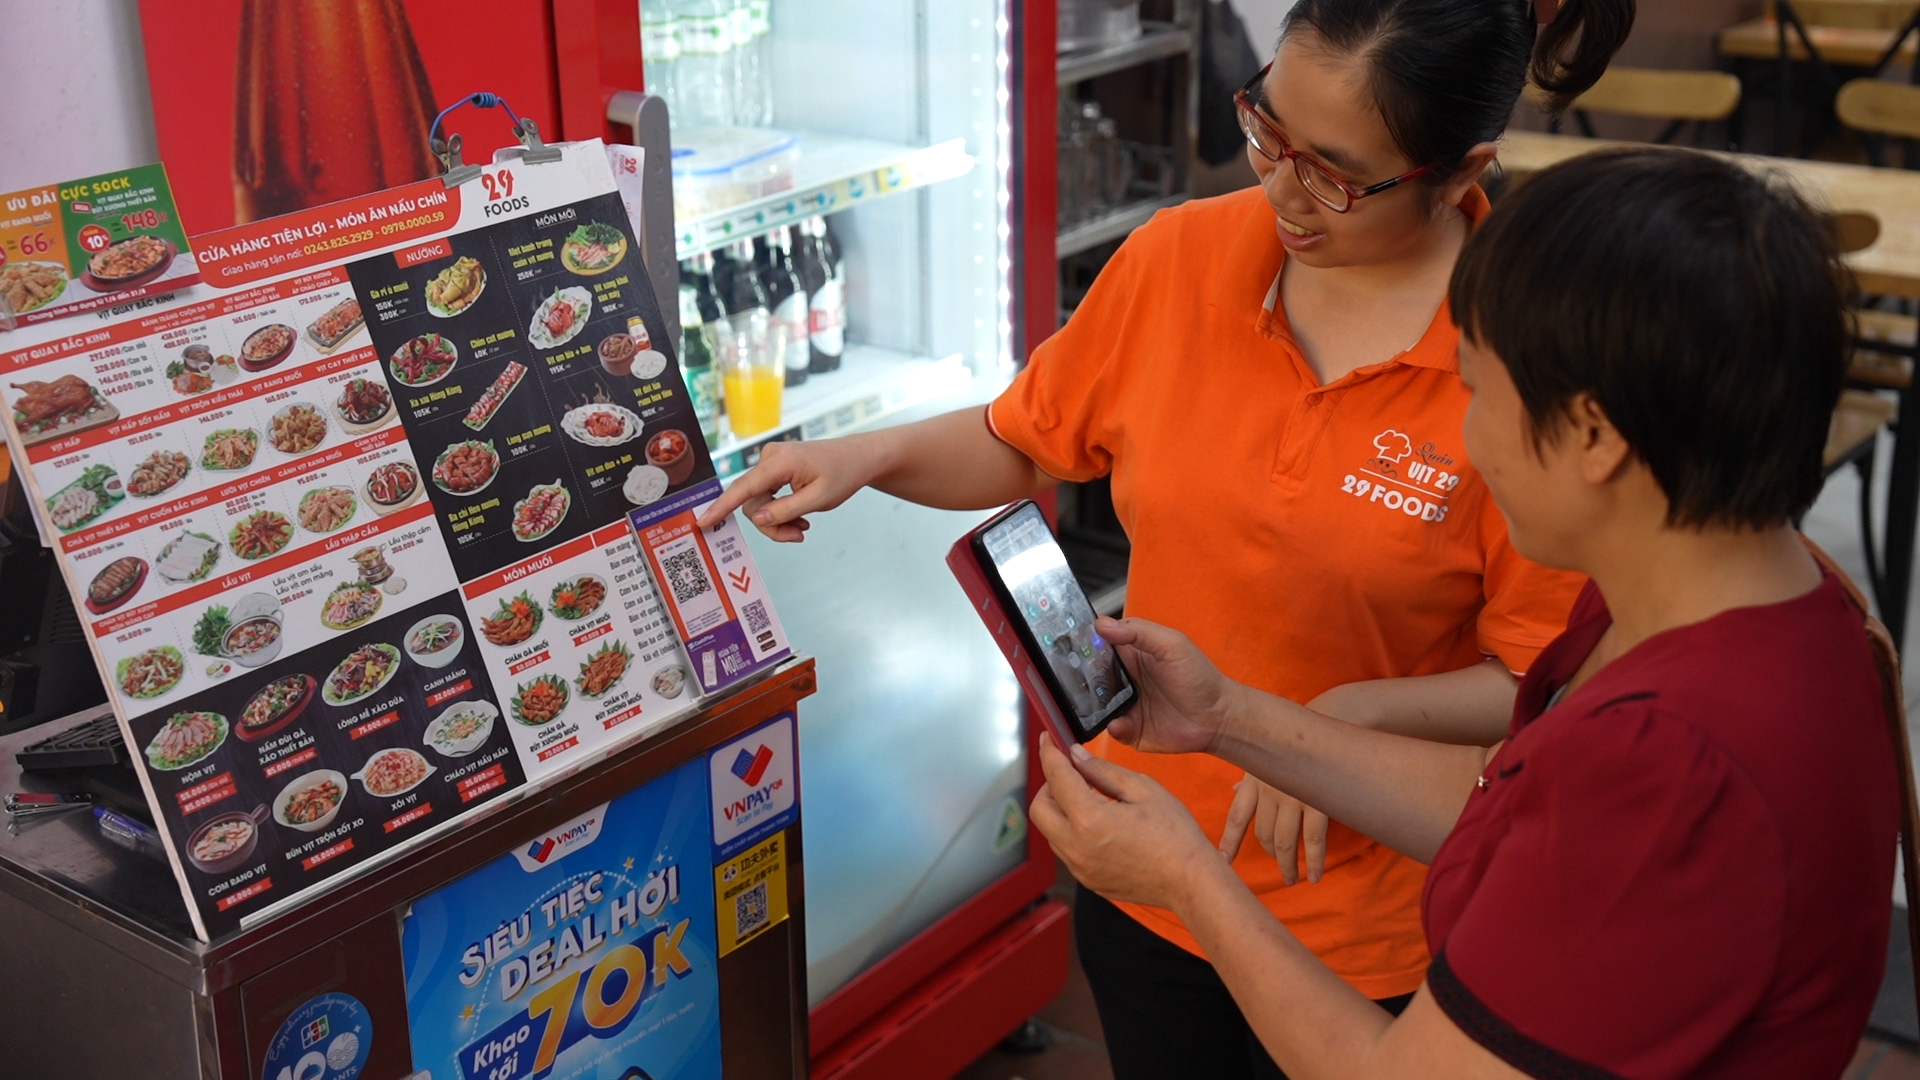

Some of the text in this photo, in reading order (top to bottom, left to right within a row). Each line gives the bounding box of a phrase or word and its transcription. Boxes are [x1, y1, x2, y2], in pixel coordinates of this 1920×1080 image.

[7, 177, 130, 211] ƯU ĐÃI CỰC SOCK
[479, 169, 515, 200] 29
[484, 196, 529, 217] FOODS
[535, 208, 576, 226] MÓN MỚI
[198, 244, 229, 263] CỬA
[230, 235, 270, 255] HÀNG
[271, 227, 303, 245] TIỆN
[304, 221, 327, 237] LỢI
[335, 211, 366, 228] MÓN
[368, 206, 387, 220] ĂN
[388, 197, 415, 215] NẤU
[417, 191, 446, 207] CHÍN
[221, 265, 243, 276] Giao
[243, 258, 268, 270] hàng
[269, 254, 285, 264] tận
[303, 229, 373, 254] 0243.825.2929
[380, 211, 444, 234] 0978.0000.59
[406, 245, 442, 261] NƯỚNG
[517, 269, 533, 280] 250K
[97, 293, 174, 319] VỊT QUAY BẮC KINH
[375, 300, 393, 310] 150K
[379, 309, 398, 320] 300K
[11, 331, 110, 364] VỊT QUAY BẮC KINH
[474, 348, 487, 358] 60K
[316, 364, 326, 372] VỊT
[327, 360, 340, 368] CAY
[341, 353, 358, 364] THIẾT
[549, 364, 564, 374] 195K
[252, 370, 302, 391] VỊT RANG MUỐI
[178, 405, 190, 413] VỊT
[210, 393, 226, 403] KIỂU
[227, 389, 243, 398] THÁI
[413, 407, 431, 418] 105K
[641, 407, 656, 417] 180K
[108, 426, 120, 434] VỊT
[120, 420, 137, 430] HẤP
[137, 415, 152, 425] SỐT
[50, 437, 80, 451] VỊT HẤP
[510, 444, 527, 455] 100K
[1415, 442, 1455, 466] Quán
[307, 457, 325, 467] RANG
[325, 450, 342, 460] MUỐI
[590, 477, 605, 488] 185K
[1434, 471, 1460, 491] 29
[1341, 474, 1448, 522] 29 FOODS
[137, 495, 207, 523] VỊT CUỐN BẮC KINH
[340, 532, 359, 544] THẬP
[400, 531, 416, 541] thập
[417, 525, 431, 534] cẩm
[457, 532, 474, 544] 105K
[238, 572, 251, 581] VỊT
[300, 577, 312, 585] om
[312, 569, 333, 581] măng
[502, 555, 552, 582] MÓN MUỐI
[568, 612, 610, 636] CHÂN VỊT MUỐI
[504, 639, 548, 664] CHÂN GÀ MUỐI
[423, 668, 466, 691] CANH MĂNG
[602, 690, 628, 707] CHÂN VỊT
[606, 701, 626, 715] XƯƠNG
[626, 693, 642, 705] MUỐI
[529, 723, 579, 752] RÚT XƯƠNG MUỐI
[537, 720, 565, 738] CHÂN GÀ
[258, 728, 305, 753] NẤM ĐÙI GÀ
[181, 769, 202, 784] NỘM
[202, 763, 215, 774] VỊT
[444, 746, 508, 782] CHÁO VỊT NẤU NẤM
[391, 793, 416, 810] XÔI VỊT
[285, 817, 364, 859] BÚN VỊT TRỘN SỐT XO
[207, 863, 266, 896] CƠM RANG VỊT
[458, 872, 603, 987] SIÊU TIỆC
[502, 864, 681, 1001] DEAL HỜI
[473, 1024, 531, 1074] Khao
[489, 1052, 519, 1080] tới
